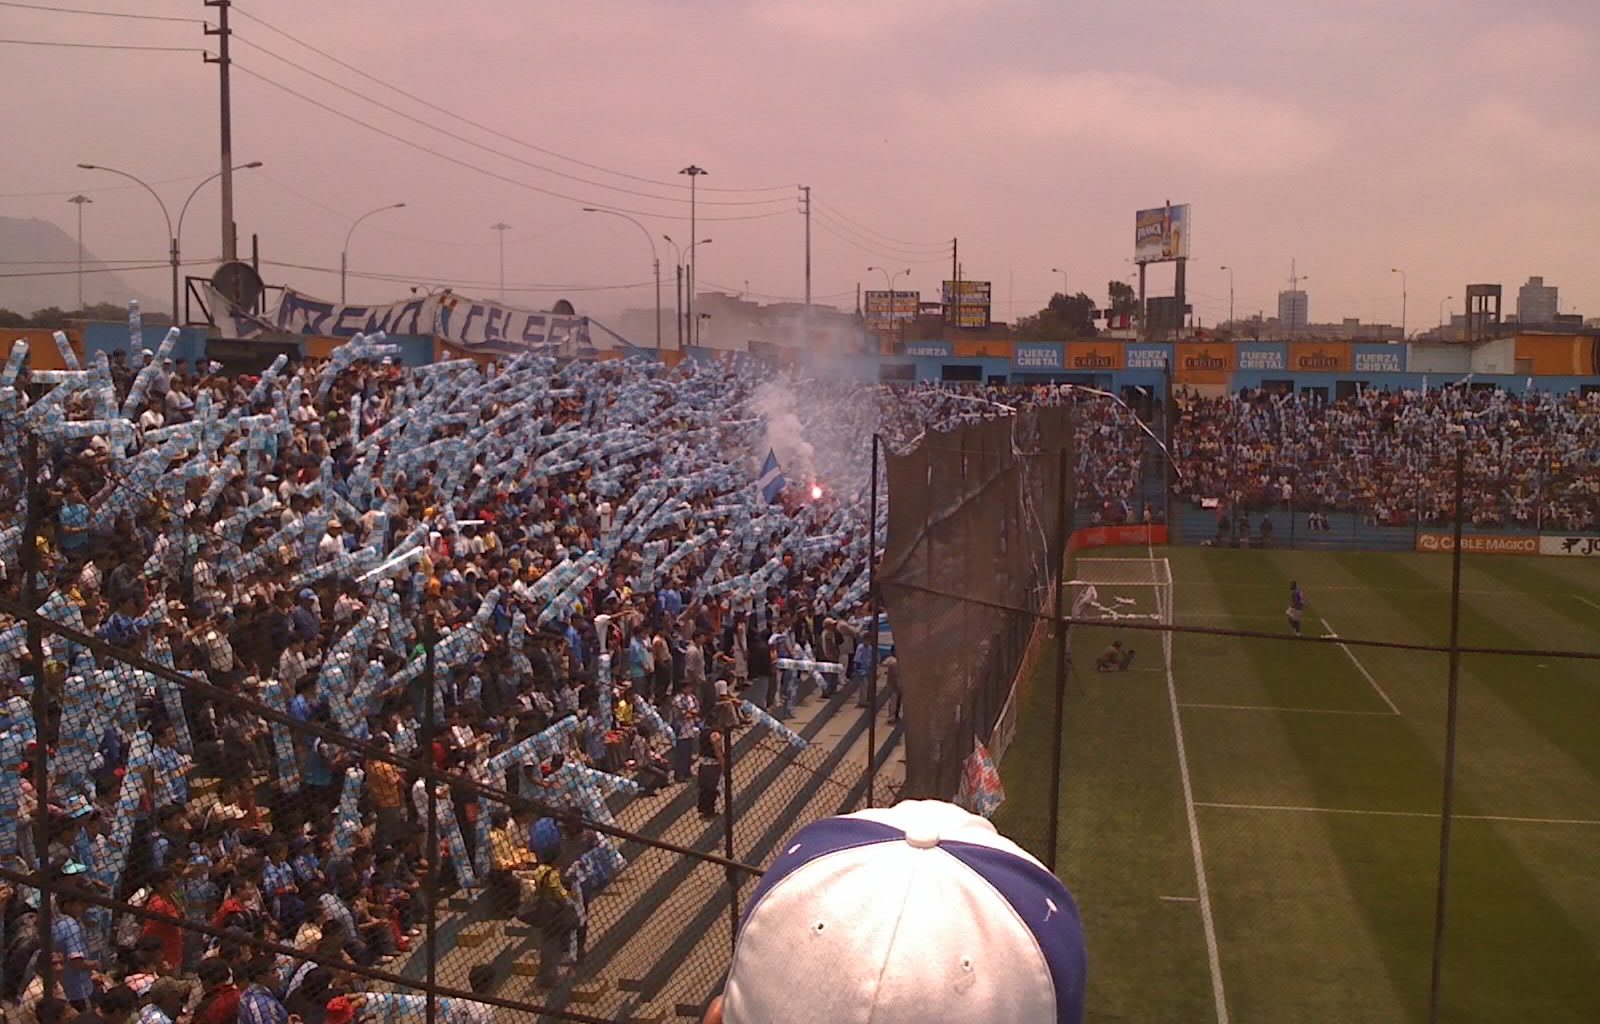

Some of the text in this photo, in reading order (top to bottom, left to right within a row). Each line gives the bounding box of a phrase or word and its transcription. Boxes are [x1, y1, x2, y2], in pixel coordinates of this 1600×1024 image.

[906, 346, 948, 356] FUERZA
[1017, 347, 1058, 358] FUERZA
[1127, 349, 1168, 359] FUERZA
[1240, 351, 1282, 361] FUERZA
[1017, 357, 1060, 368] CRISTAL
[1356, 353, 1399, 363] FUERZA
[1239, 360, 1284, 370] CRISTAL
[1355, 362, 1401, 373] CRISTAL
